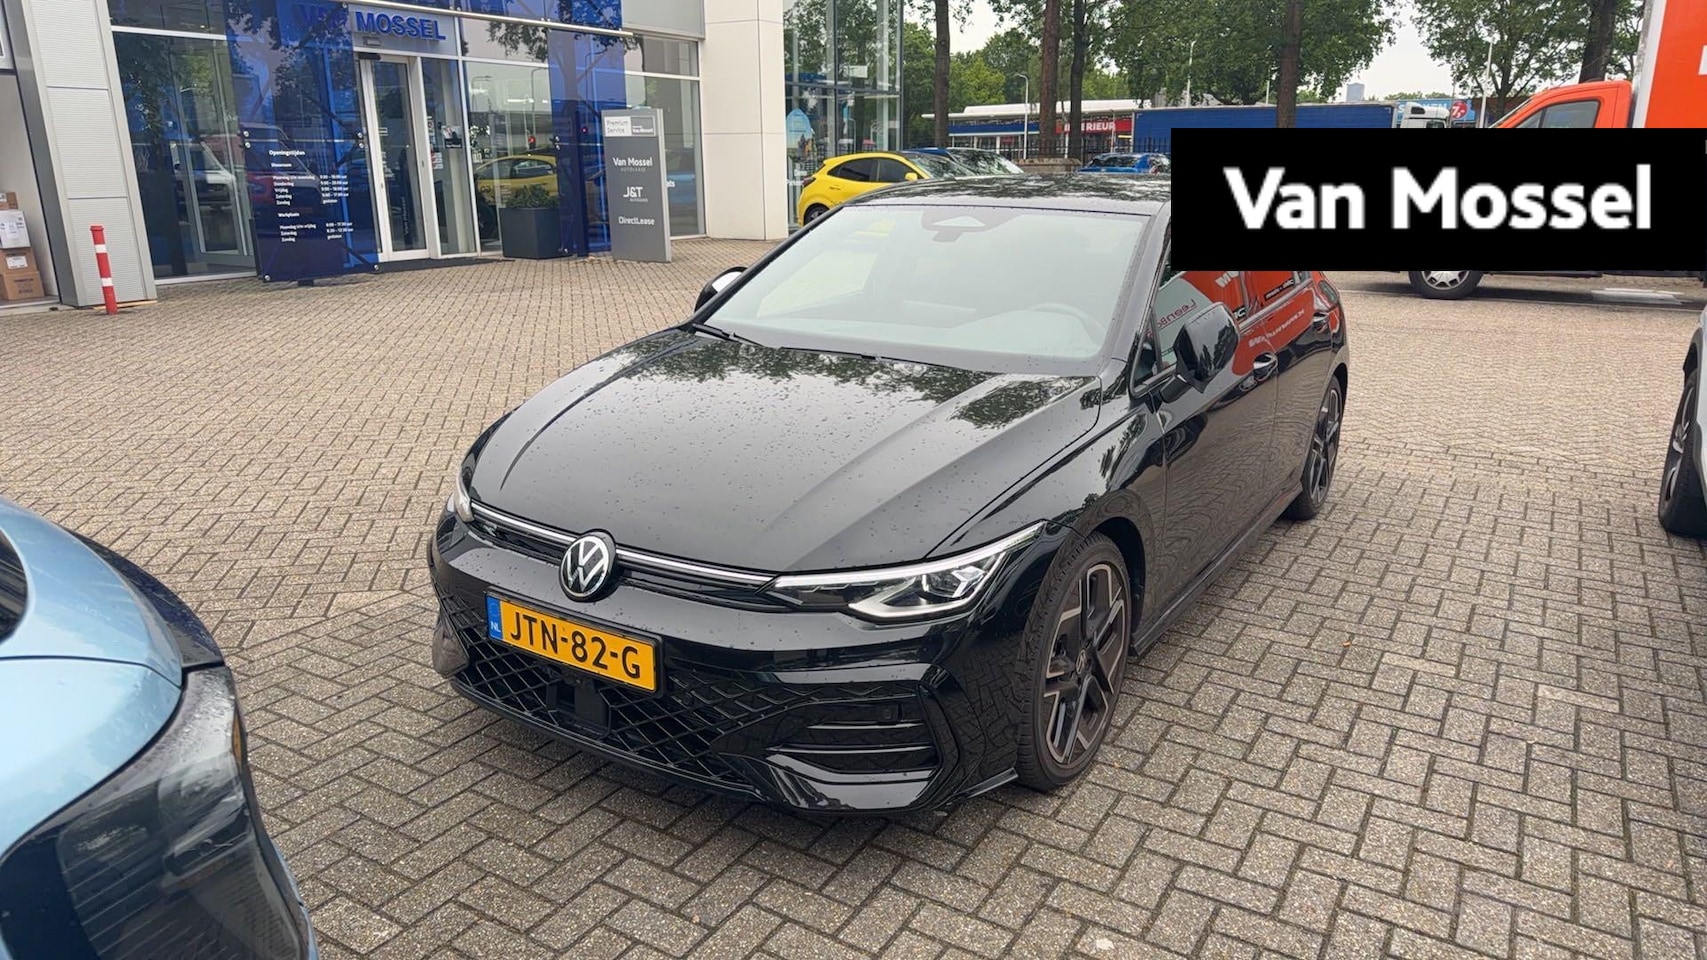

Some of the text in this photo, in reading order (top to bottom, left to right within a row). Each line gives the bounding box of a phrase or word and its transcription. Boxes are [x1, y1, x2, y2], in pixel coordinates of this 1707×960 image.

[355, 11, 446, 40] MOSSEL
[613, 157, 653, 167] Van Mossel
[623, 186, 643, 198] J&T
[618, 216, 655, 226] DirectLease
[491, 621, 501, 633] NL
[510, 612, 641, 679] JTN-82-G
